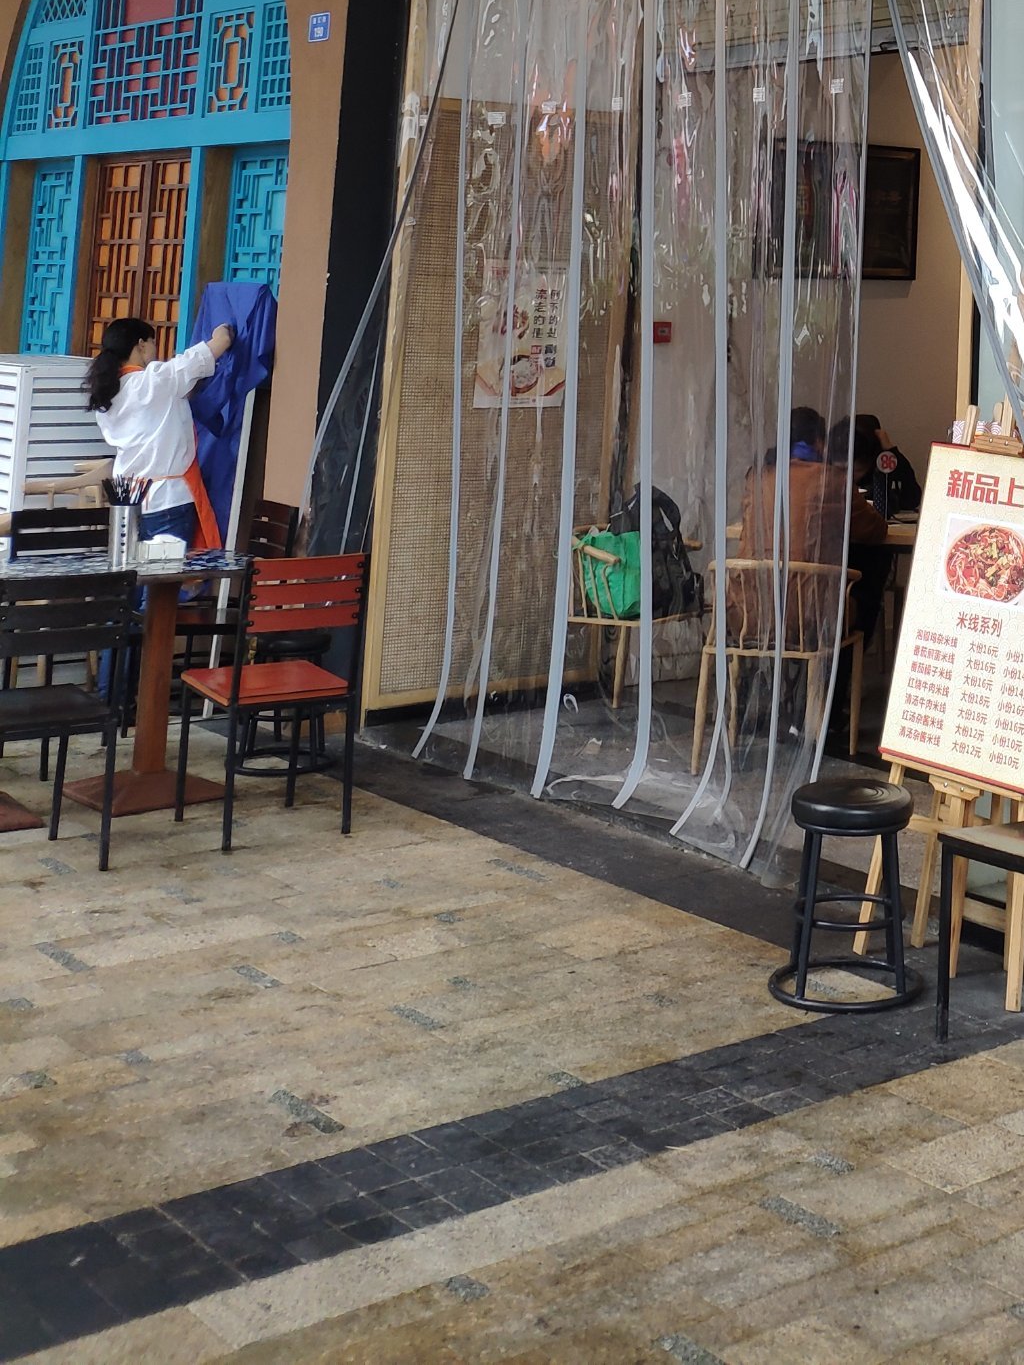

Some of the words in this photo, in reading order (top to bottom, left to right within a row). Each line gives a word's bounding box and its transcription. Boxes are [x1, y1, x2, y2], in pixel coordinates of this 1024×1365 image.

[880, 454, 897, 471] 86
[956, 610, 1003, 638] 米线系列
[967, 640, 1000, 658] 大份16元
[965, 657, 997, 675] 大份16元
[962, 673, 994, 692] 大份16元
[959, 690, 991, 709] 大份18元
[956, 706, 988, 726] 大份18元
[954, 723, 985, 742] 大份12元
[991, 733, 1023, 753] 小份10元
[951, 740, 982, 759] 大份12元
[988, 750, 1020, 770] 小份10元
